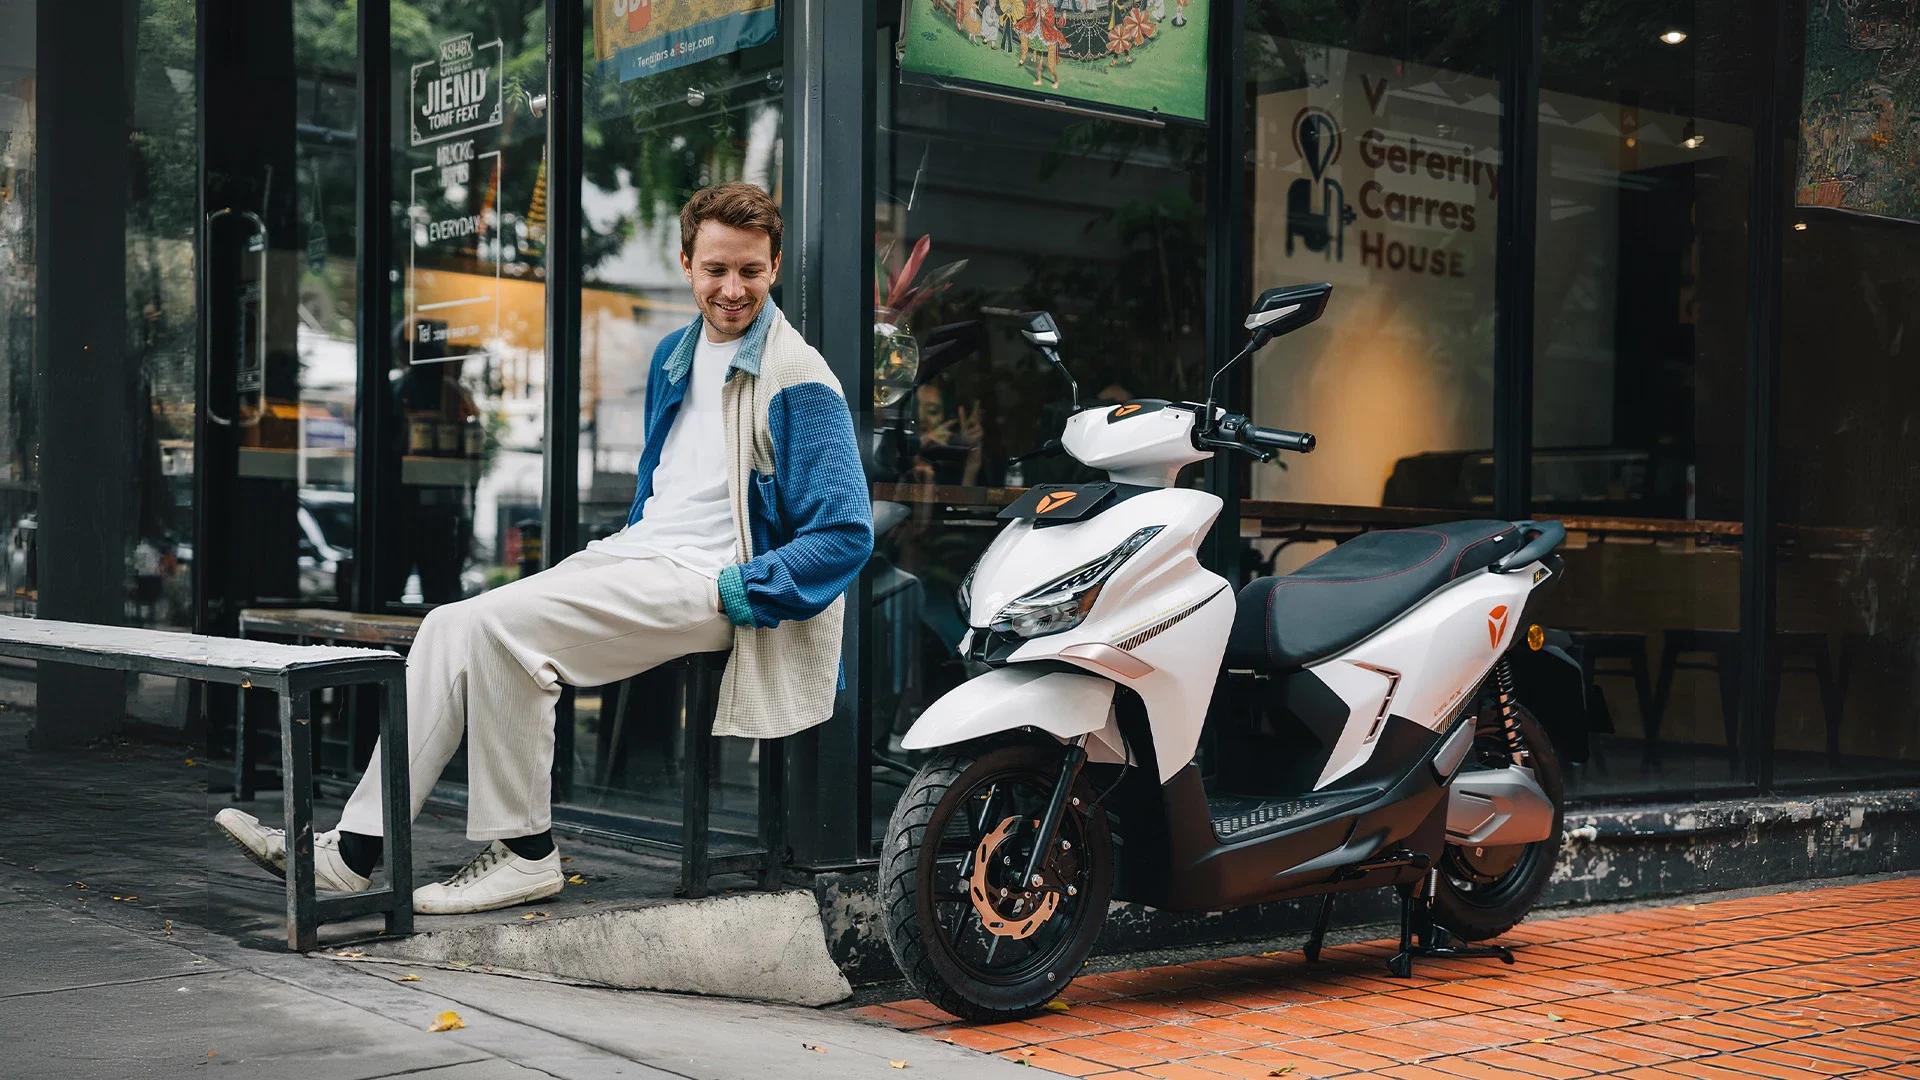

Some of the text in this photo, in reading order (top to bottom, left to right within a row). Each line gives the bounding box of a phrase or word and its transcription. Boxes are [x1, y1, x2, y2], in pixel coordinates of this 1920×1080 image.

[1361, 74, 1388, 115] V
[1359, 180, 1476, 232] Carres
[429, 215, 481, 242] EVERYDAY
